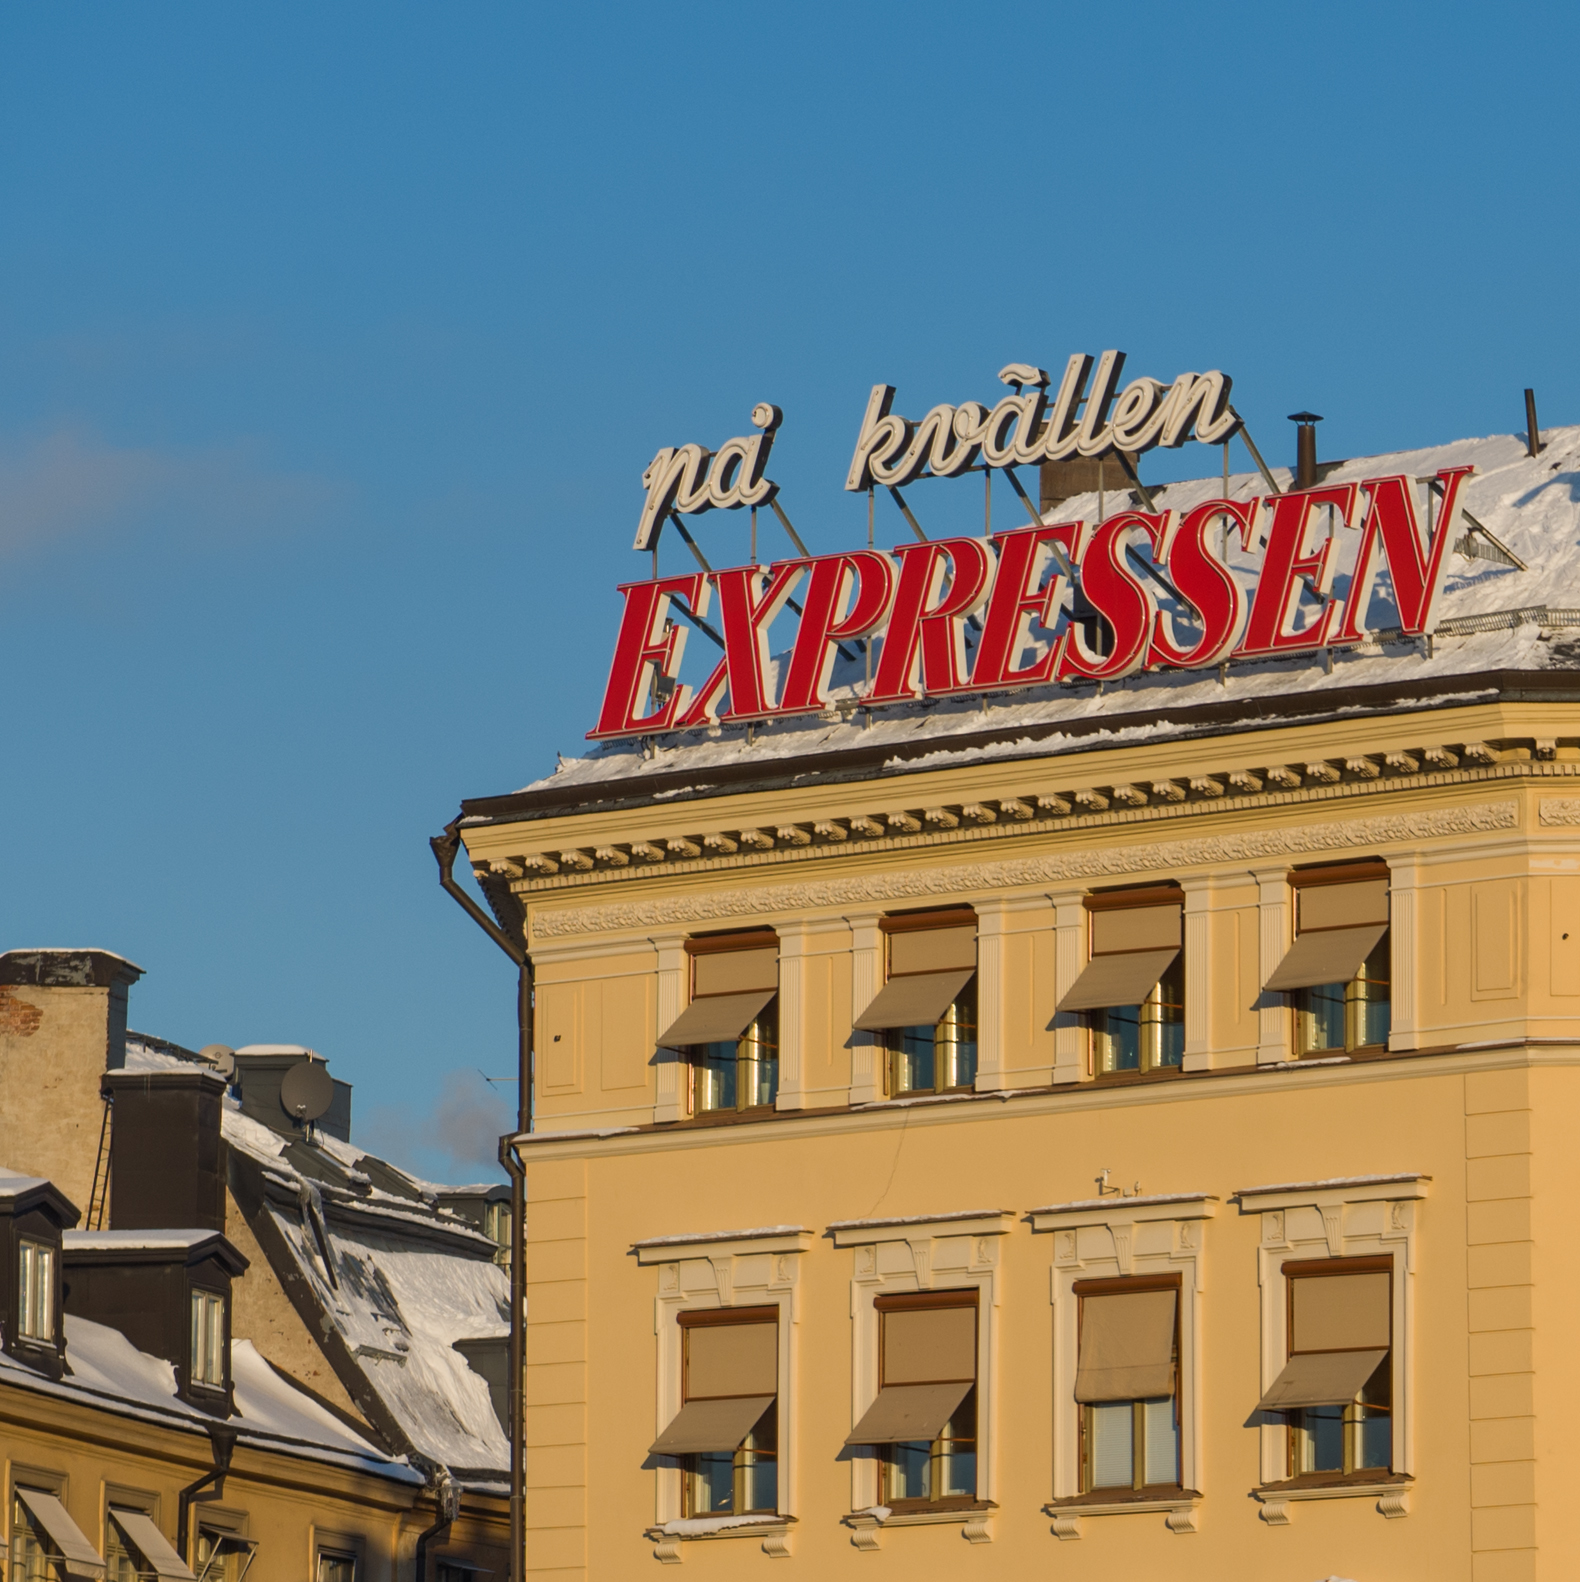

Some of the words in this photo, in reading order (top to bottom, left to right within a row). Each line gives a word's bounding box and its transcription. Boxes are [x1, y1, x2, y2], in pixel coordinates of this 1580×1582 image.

[633, 402, 782, 552] på
[844, 350, 1245, 492] kvällen
[585, 464, 1479, 741] EXPRESSEN
